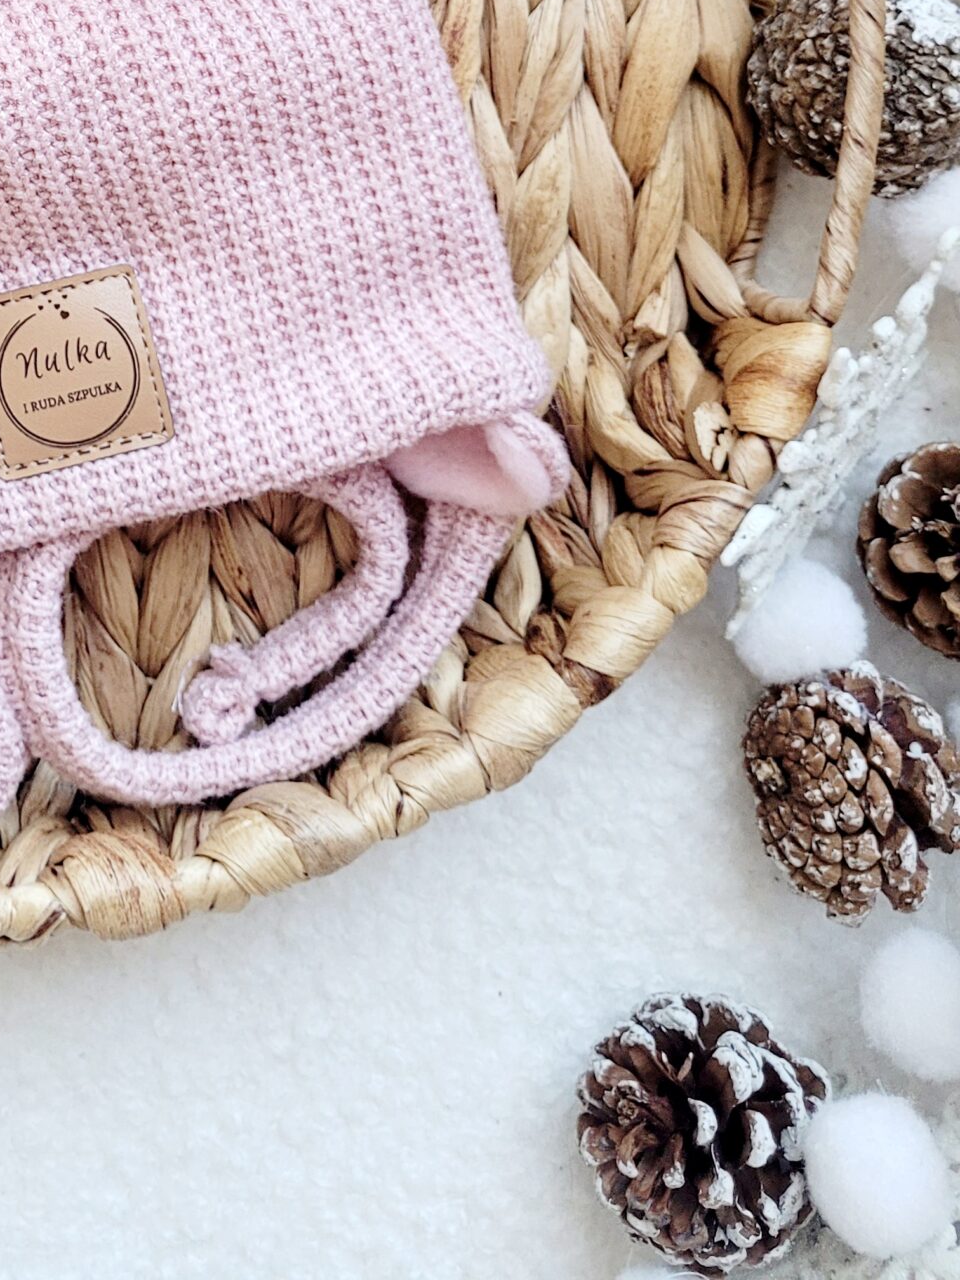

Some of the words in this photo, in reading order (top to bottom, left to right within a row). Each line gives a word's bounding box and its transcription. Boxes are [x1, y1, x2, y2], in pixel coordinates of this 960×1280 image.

[16, 337, 111, 379] Nulka
[23, 403, 29, 414] I
[31, 395, 66, 412] RUDA
[68, 381, 123, 404] SZPULKA
